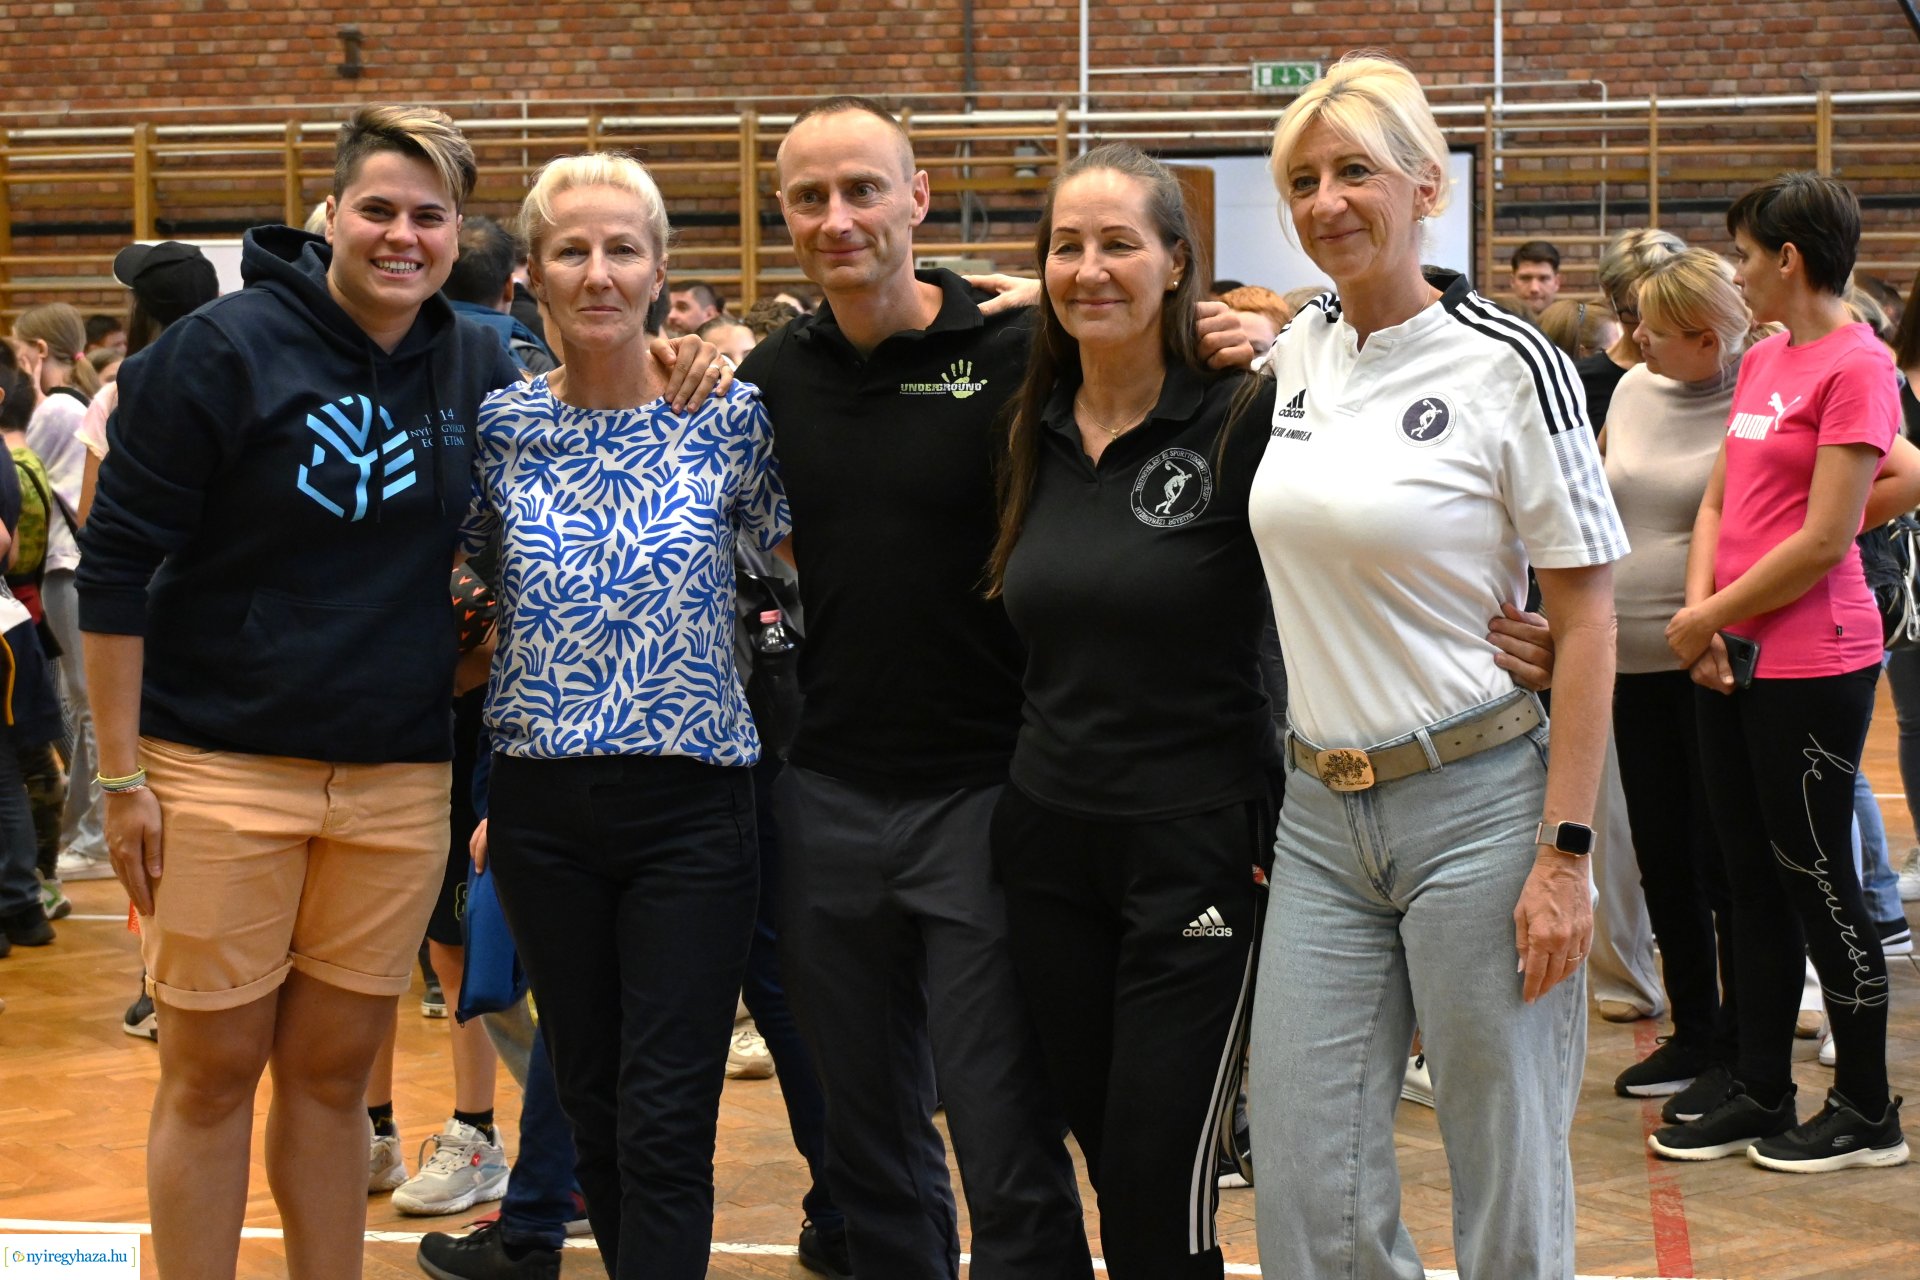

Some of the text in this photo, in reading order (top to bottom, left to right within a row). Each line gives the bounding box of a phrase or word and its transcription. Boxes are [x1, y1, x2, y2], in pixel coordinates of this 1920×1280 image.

[900, 382, 982, 392] UNDERGROUND
[424, 408, 454, 424] 114
[1278, 407, 1306, 419] adidas
[1726, 412, 1775, 441] PUMA
[1283, 429, 1312, 442] ANDREA
[1770, 733, 1889, 1015] be yourself
[1182, 925, 1233, 937] adidas
